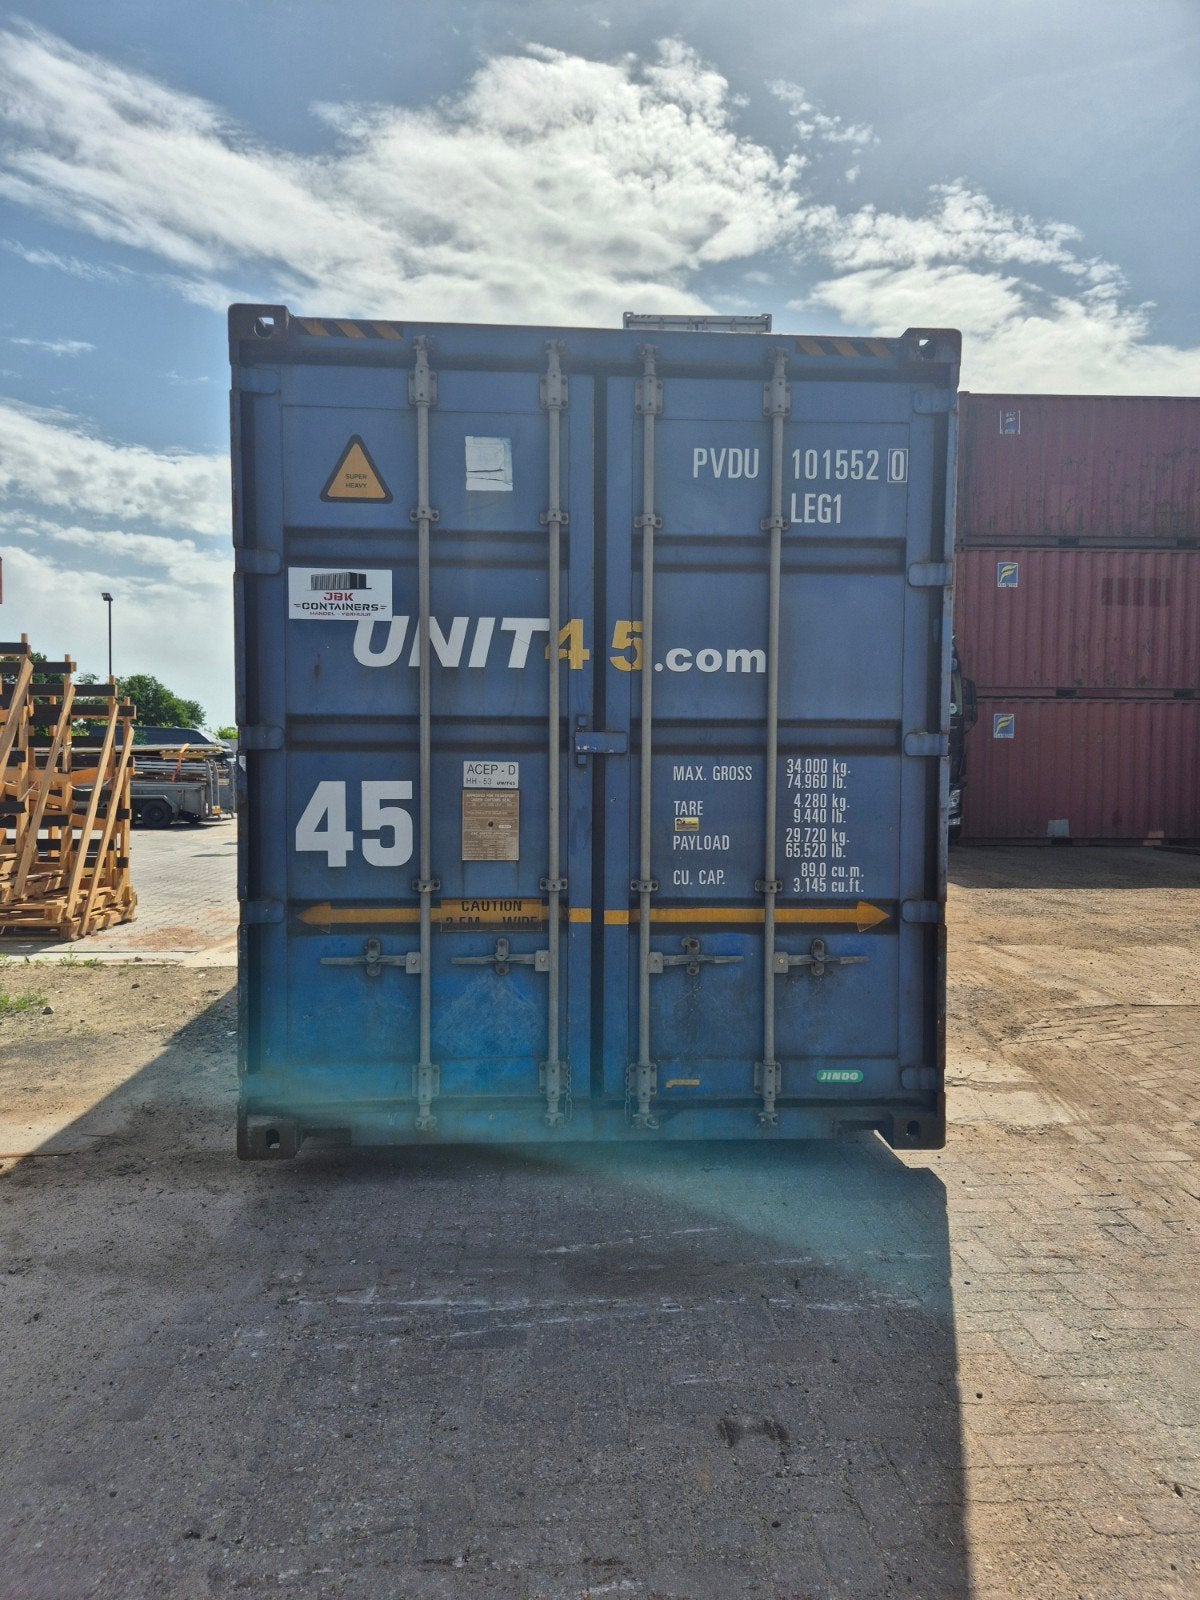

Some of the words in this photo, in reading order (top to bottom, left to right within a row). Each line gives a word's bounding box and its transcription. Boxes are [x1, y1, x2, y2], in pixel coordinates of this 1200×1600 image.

[692, 447, 760, 479] PVDU
[792, 448, 879, 481] 101552
[790, 492, 842, 524] LEG1
[323, 592, 354, 602] JBK
[301, 601, 379, 612] CONTAINERS
[467, 764, 499, 775] ACEP
[508, 764, 516, 776] D
[673, 765, 707, 781] MAX.
[712, 765, 753, 781] GROSS
[832, 758, 851, 778] kg.
[466, 777, 477, 785] HH
[832, 774, 847, 789] lb.
[673, 800, 704, 816] TARE
[832, 793, 851, 811] kg.
[831, 808, 847, 823] lb.
[295, 780, 414, 868] 45
[673, 835, 730, 850] PAYLOAD
[831, 827, 850, 846] kg.
[831, 843, 847, 858] lb.
[673, 869, 693, 886] CU.
[698, 869, 726, 885] CAP.
[801, 862, 827, 877] 89.0
[831, 866, 865, 878] cu.m.
[831, 877, 865, 893] cu.ft.
[461, 900, 522, 912] CAUTION
[820, 1071, 859, 1081] JINDO
